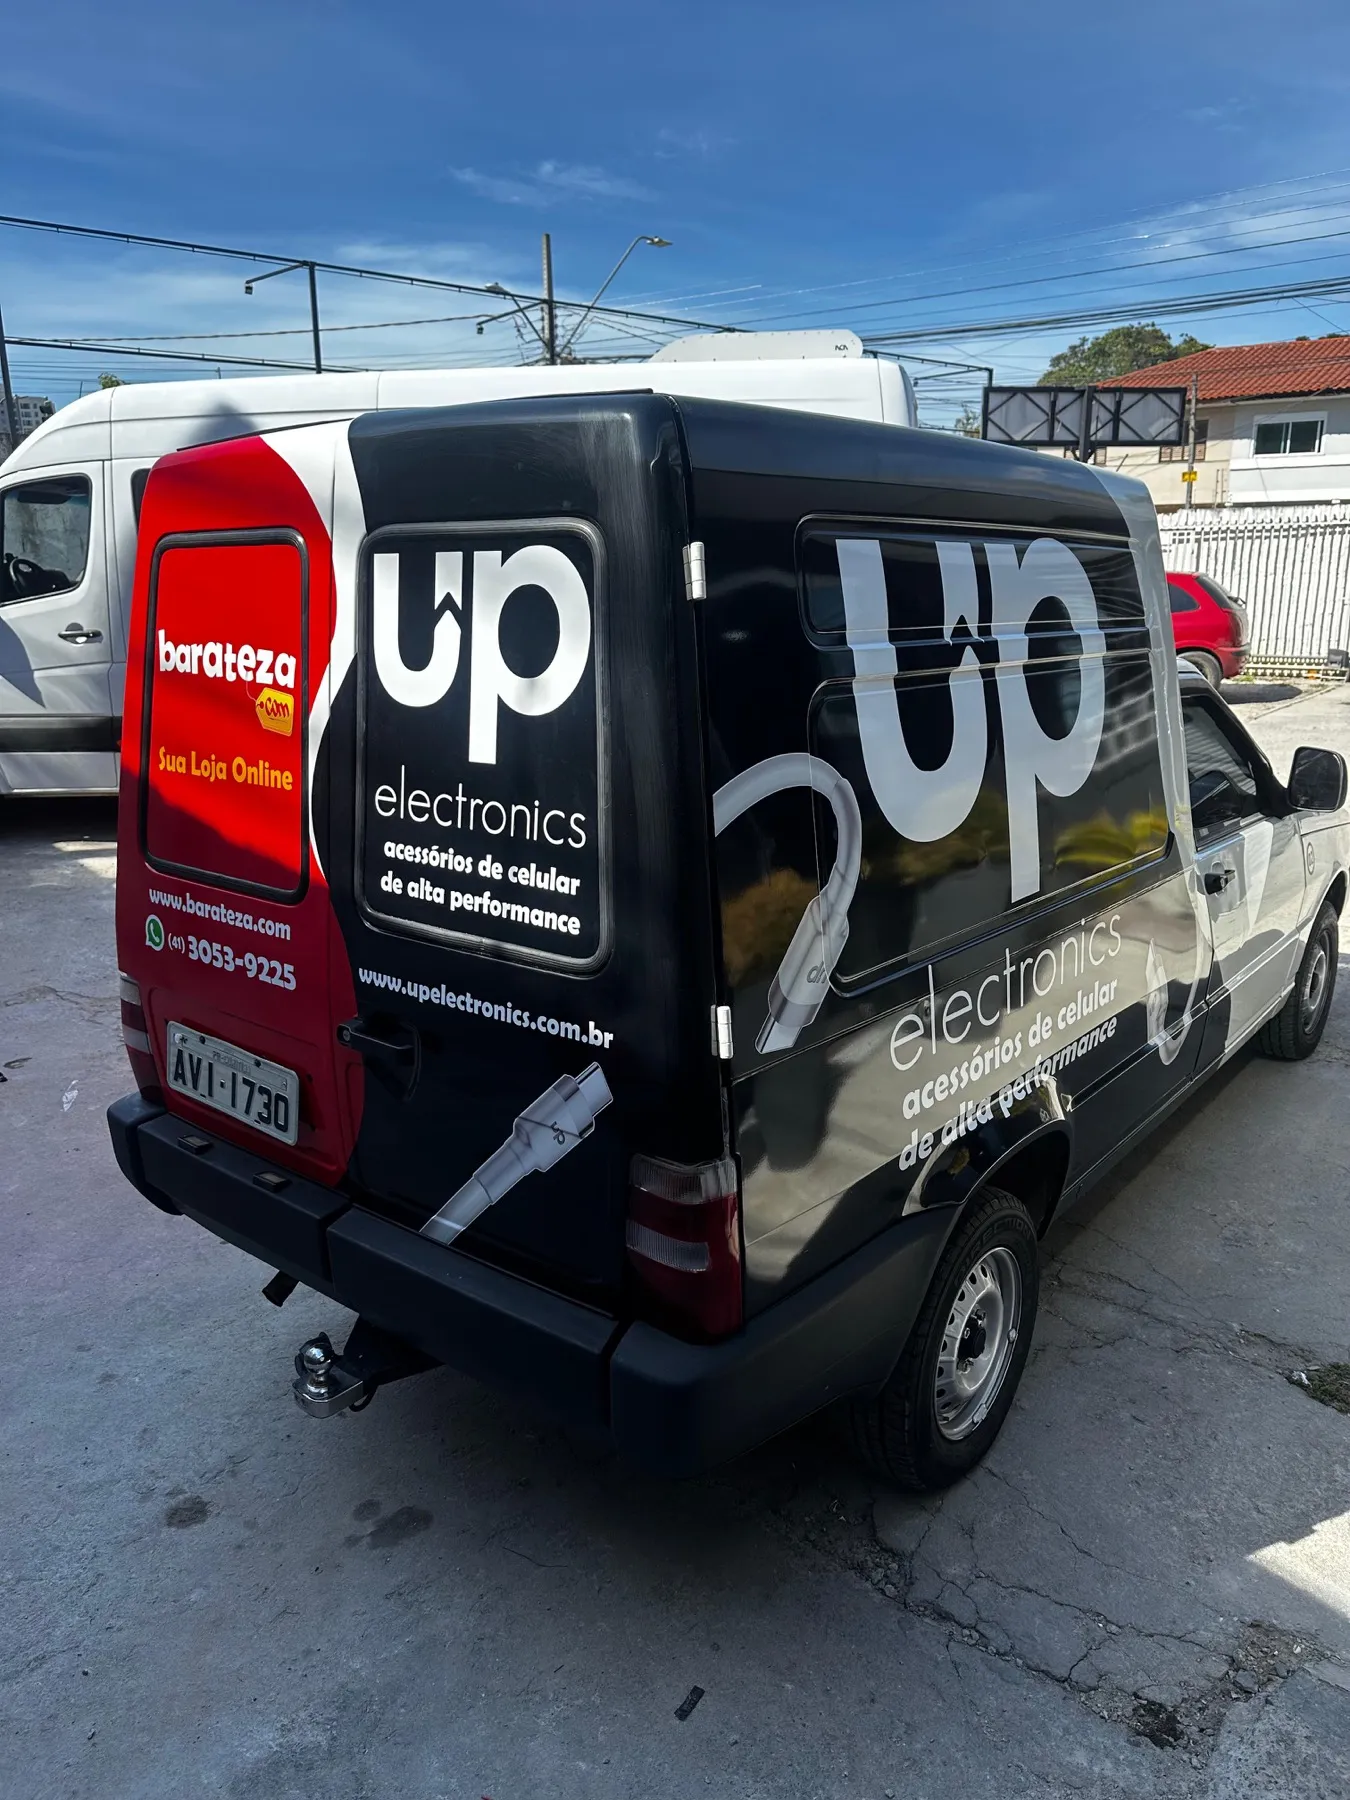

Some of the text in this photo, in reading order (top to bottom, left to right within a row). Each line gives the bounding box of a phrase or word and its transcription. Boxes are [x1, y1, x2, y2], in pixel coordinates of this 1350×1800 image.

[158, 629, 296, 688] barateza
[373, 545, 591, 765] up
[835, 537, 1106, 904] up
[159, 746, 293, 791] Sua Loja Online
[374, 765, 587, 848] electronics
[380, 870, 581, 935] de alta performance
[384, 841, 581, 896] acessórios de celular
[149, 888, 291, 940] www.barateza.com
[168, 933, 297, 990] (41) 3053-9225
[890, 914, 1122, 1071] electronics
[358, 967, 614, 1049] www.upelectronics.com.br
[903, 979, 1118, 1119] acessórios de celular
[899, 1016, 1118, 1171] de alta performance
